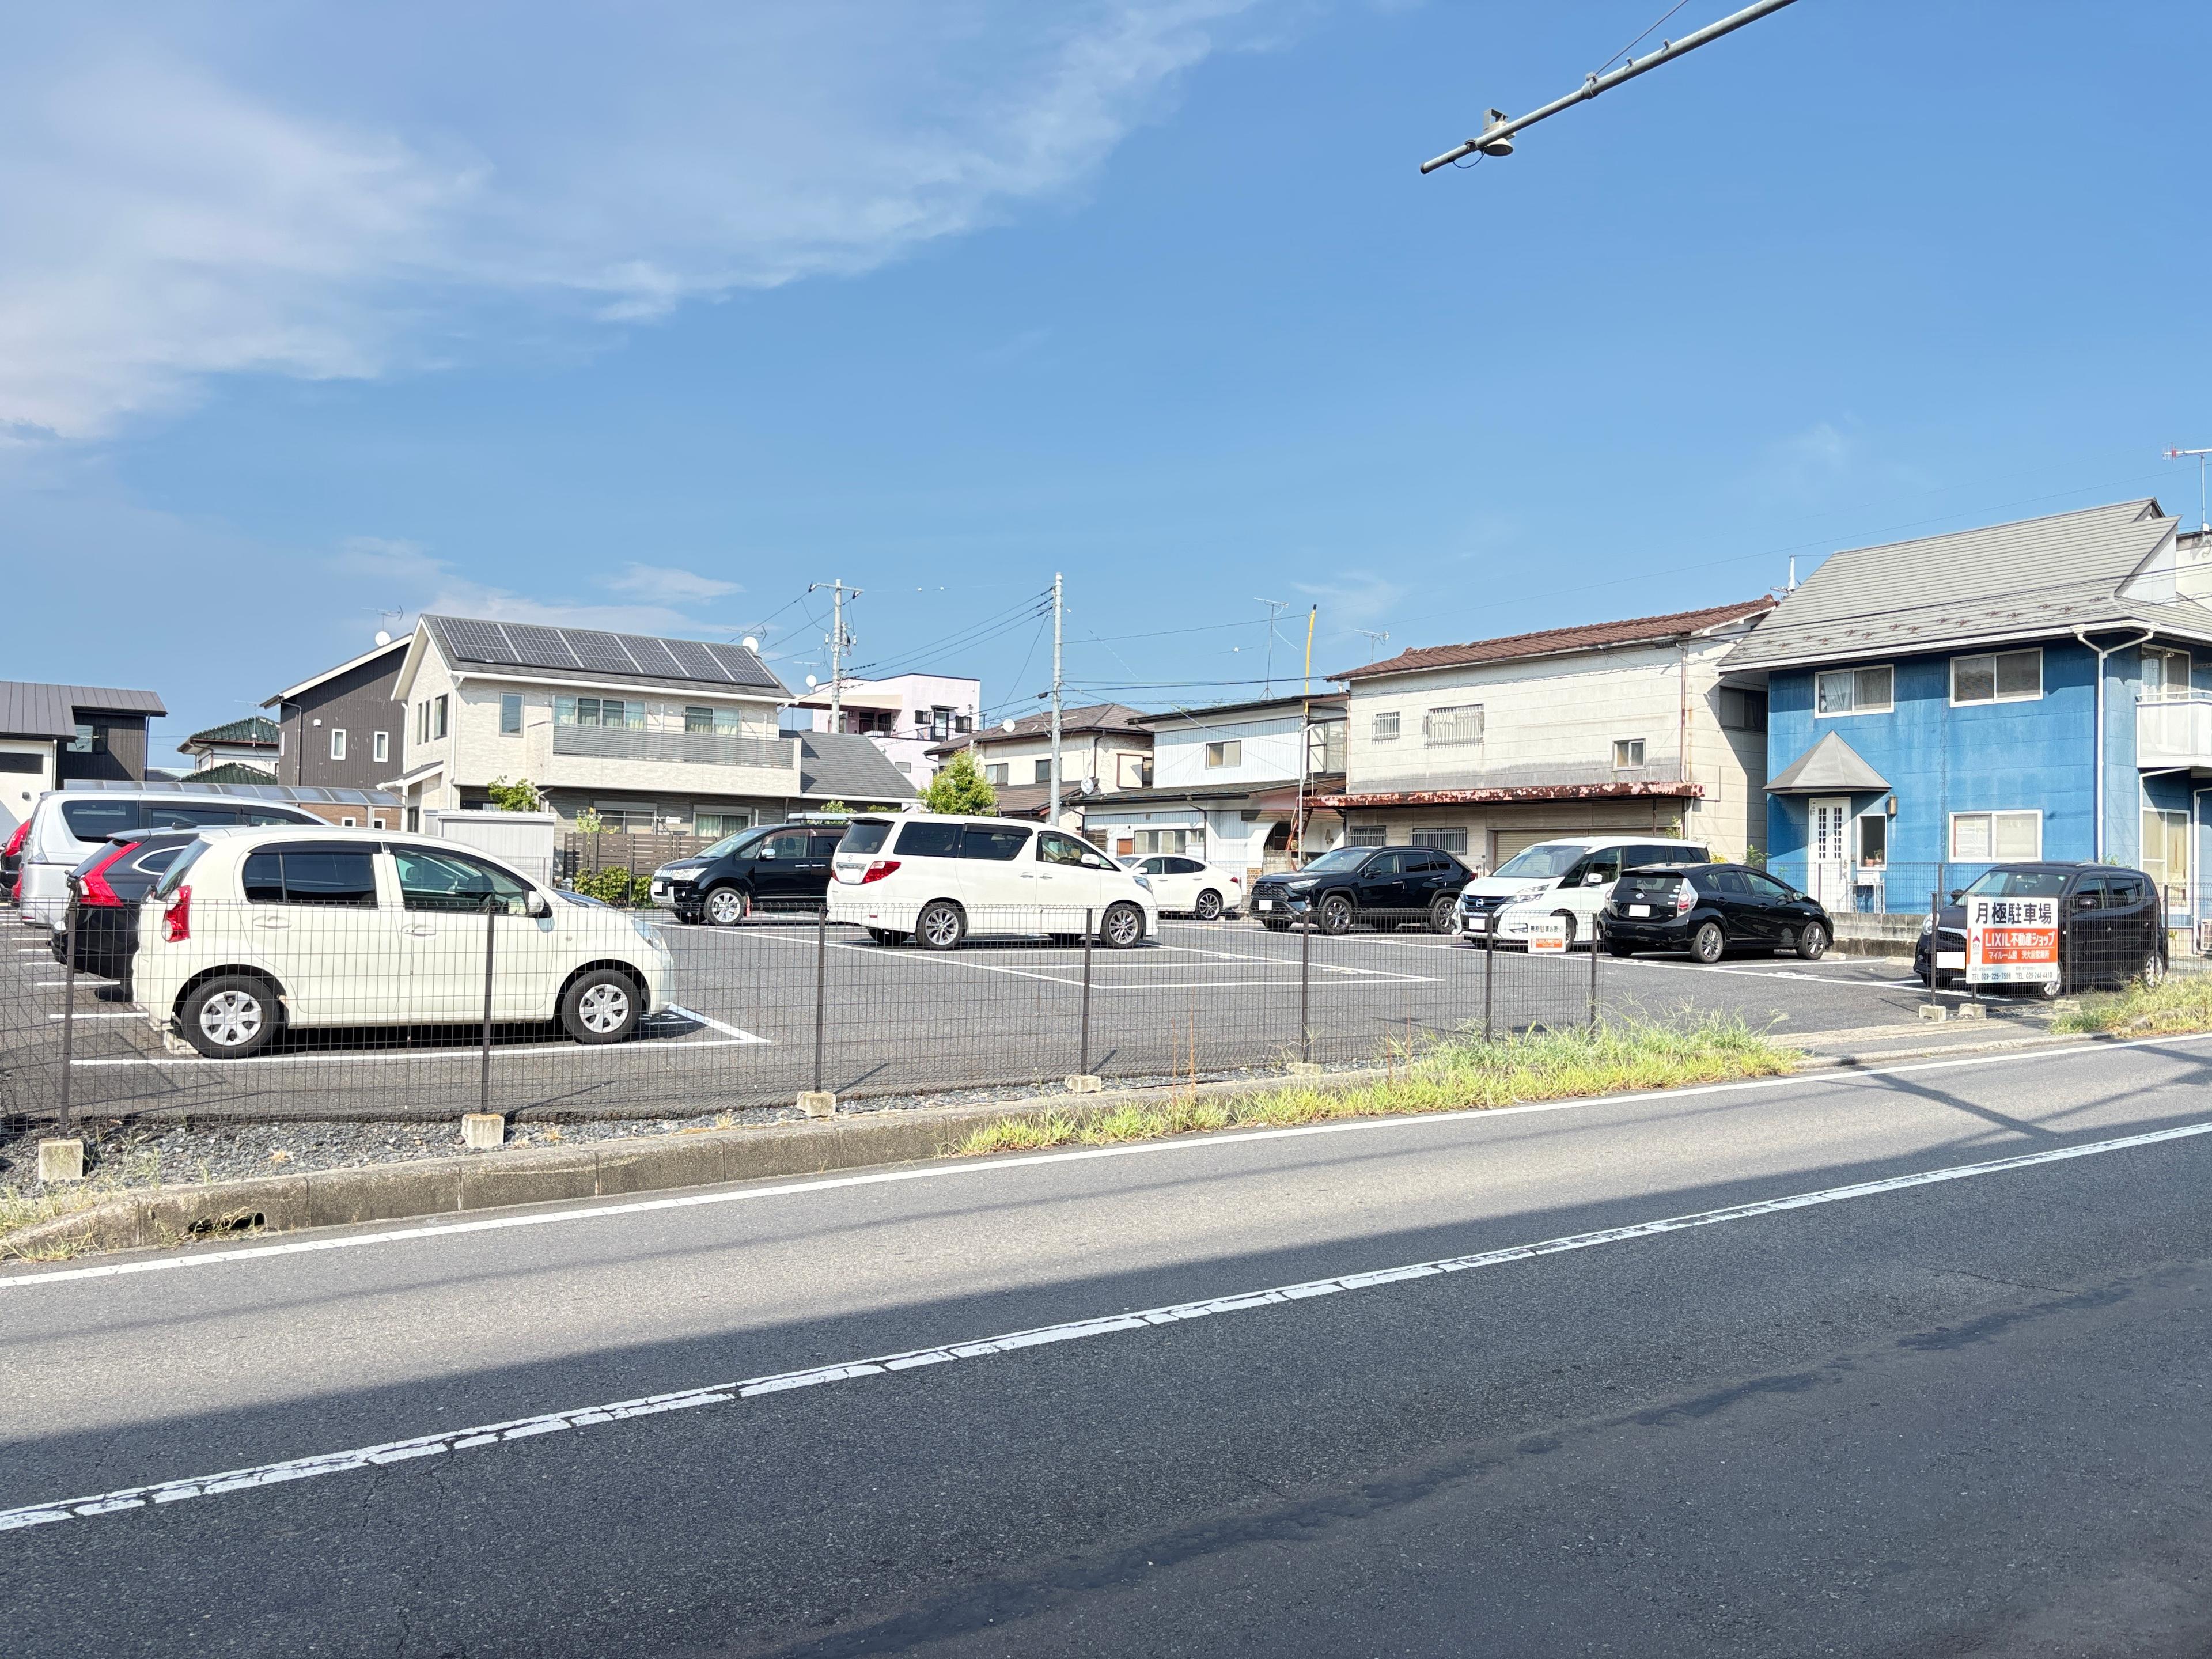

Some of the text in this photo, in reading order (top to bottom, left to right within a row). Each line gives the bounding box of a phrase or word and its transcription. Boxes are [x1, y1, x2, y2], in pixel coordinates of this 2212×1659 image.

[1975, 903, 2052, 924] 月極駐車場
[1985, 931, 2055, 947] LIXIL不動産ショップ
